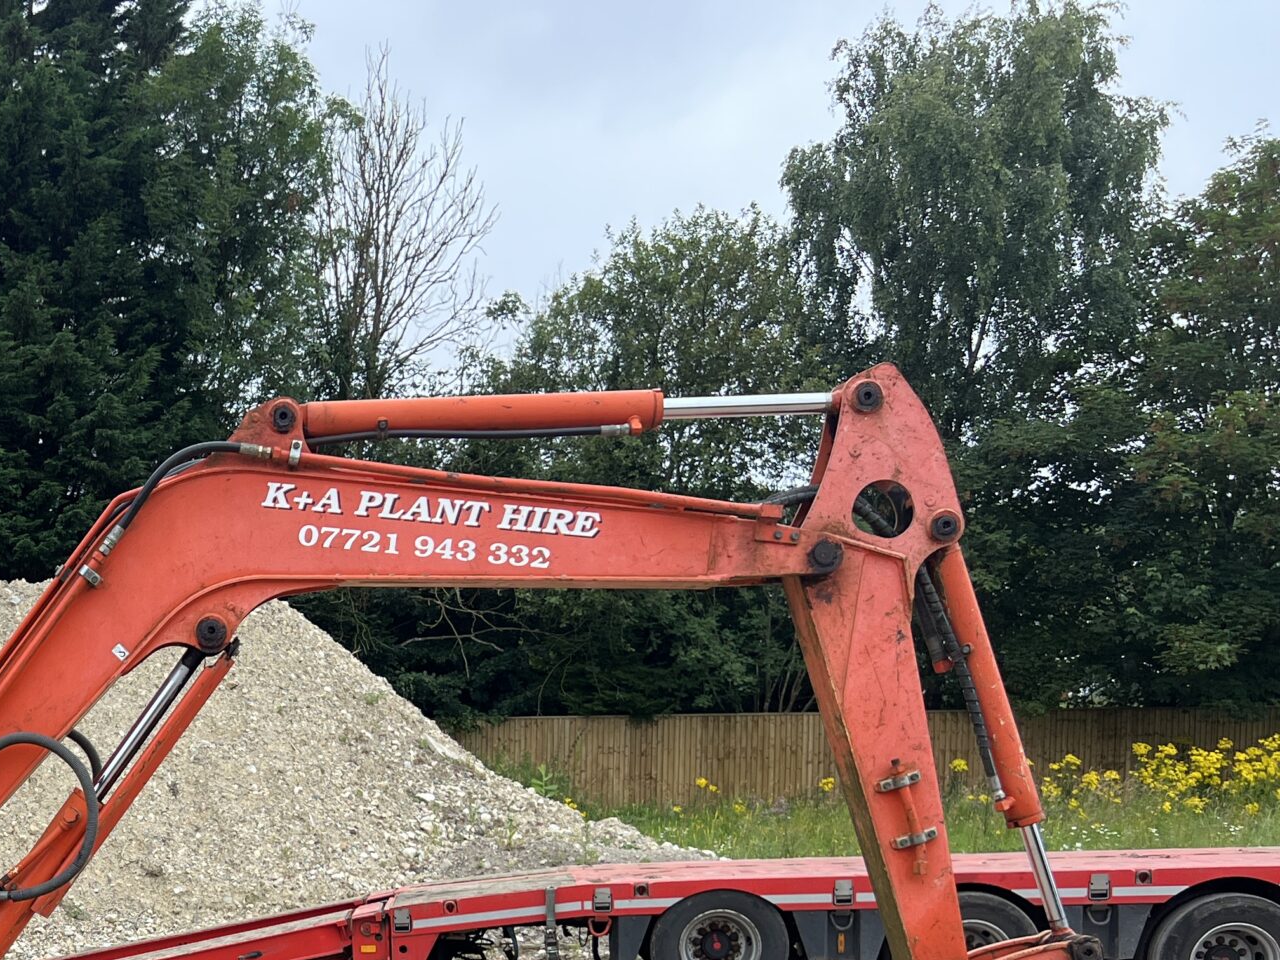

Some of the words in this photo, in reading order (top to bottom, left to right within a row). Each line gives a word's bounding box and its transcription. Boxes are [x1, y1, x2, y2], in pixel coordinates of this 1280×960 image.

[261, 481, 342, 515] K+A
[354, 490, 490, 528] PLANT
[497, 503, 602, 539] HIRE
[298, 524, 400, 555] 07721
[413, 535, 477, 562] 943
[487, 542, 551, 569] 332
